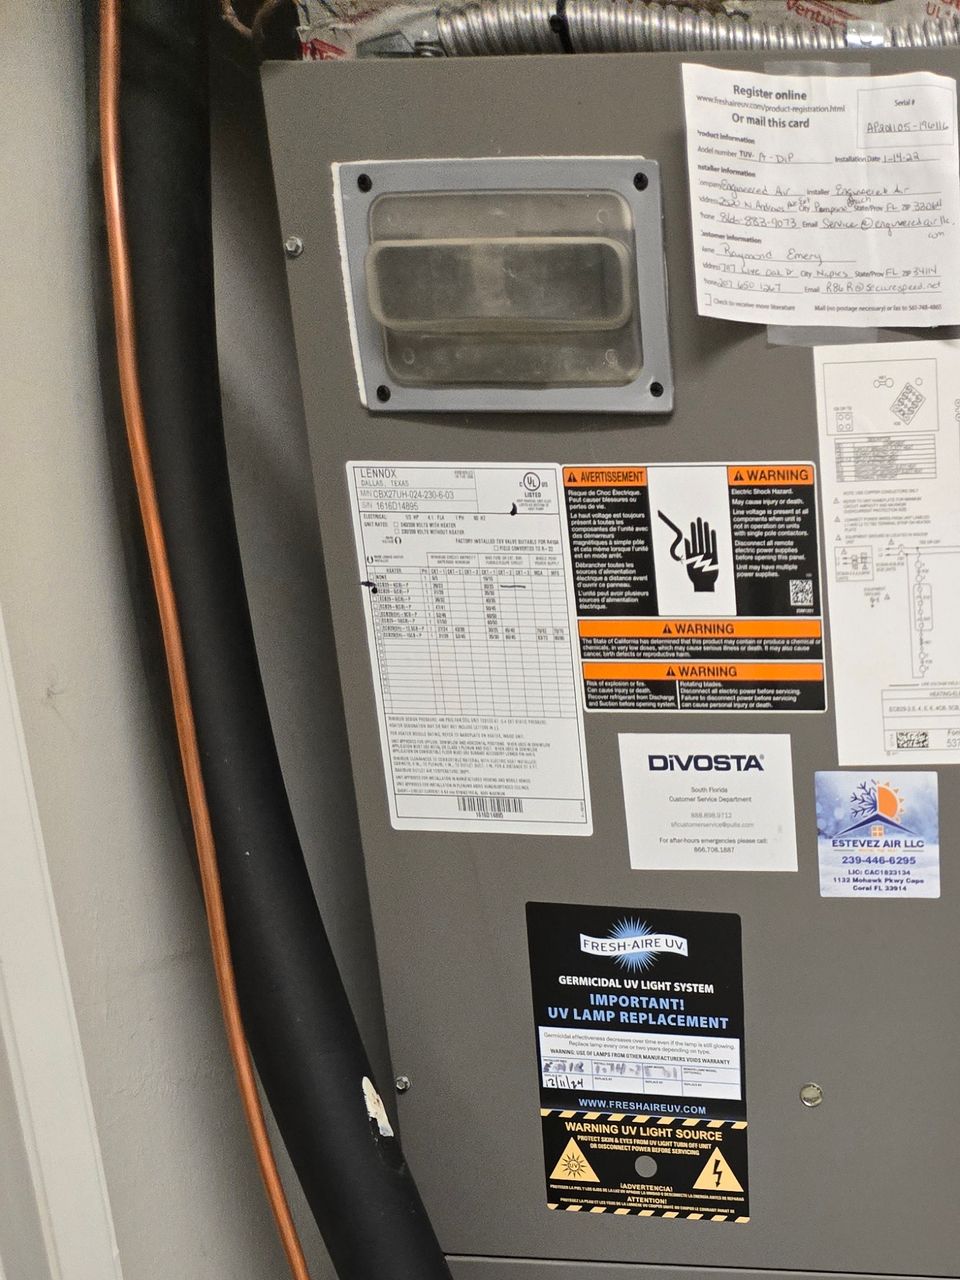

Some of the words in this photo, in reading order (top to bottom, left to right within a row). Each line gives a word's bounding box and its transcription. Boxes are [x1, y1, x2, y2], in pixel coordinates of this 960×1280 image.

[733, 84, 773, 100] Register
[775, 89, 807, 101] online
[731, 112, 745, 124] Or
[747, 115, 766, 127] mail
[768, 117, 786, 128] this
[788, 118, 809, 129] card
[360, 469, 397, 479] LENNOX
[580, 471, 643, 483] AVERTISSEMENT
[746, 470, 809, 481] WARNING
[731, 487, 753, 495] Electric
[753, 487, 771, 495] Shock
[732, 498, 744, 507] May
[675, 623, 735, 635] WARNING
[678, 666, 738, 677] WARNING
[648, 754, 765, 772] DiVOSTA
[718, 796, 752, 804] Department
[701, 838, 736, 846] emergencies
[737, 838, 755, 846] please
[831, 839, 881, 849] ESTEVEZ
[883, 839, 901, 849] AIR
[904, 839, 925, 849] LLC
[841, 856, 917, 865] 239-446-6295
[884, 877, 904, 886] Pkwy
[905, 877, 925, 886] Cape
[852, 884, 872, 892] Coral
[583, 937, 661, 953] FRESH-AIRE
[664, 937, 685, 951] UV
[558, 974, 622, 990] GERMICIDAL
[623, 979, 640, 990] UV
[640, 980, 672, 993] LIGHT
[673, 982, 715, 995] SYSTEM
[589, 993, 686, 1012] IMPORTANT!
[547, 1006, 569, 1020] UV
[573, 1008, 616, 1024] LAMP
[619, 1010, 730, 1031] REPLACEMENT
[592, 1050, 611, 1058] LAMPS
[611, 1051, 626, 1059] FROM
[642, 1053, 686, 1063] MANUFACTURERS
[702, 1057, 731, 1066] WARRANTY
[578, 1098, 708, 1115] WWW.FRESHAIREUV.COM
[564, 1121, 619, 1135] WARNING
[621, 1126, 638, 1136] UV
[640, 1126, 673, 1138] LIGHT
[675, 1129, 723, 1142] SOURCE
[576, 1134, 600, 1144] PROTECT
[600, 1136, 615, 1144] SKIN
[619, 1137, 633, 1145] EYES
[633, 1138, 648, 1146] FROM
[657, 1139, 673, 1147] LIGHT
[598, 1143, 632, 1153] DISCONNECT
[631, 1145, 651, 1154] POWER
[651, 1146, 671, 1155] BEFORE
[671, 1148, 700, 1157] SERVICING
[626, 1195, 669, 1205] ATTENTION!
